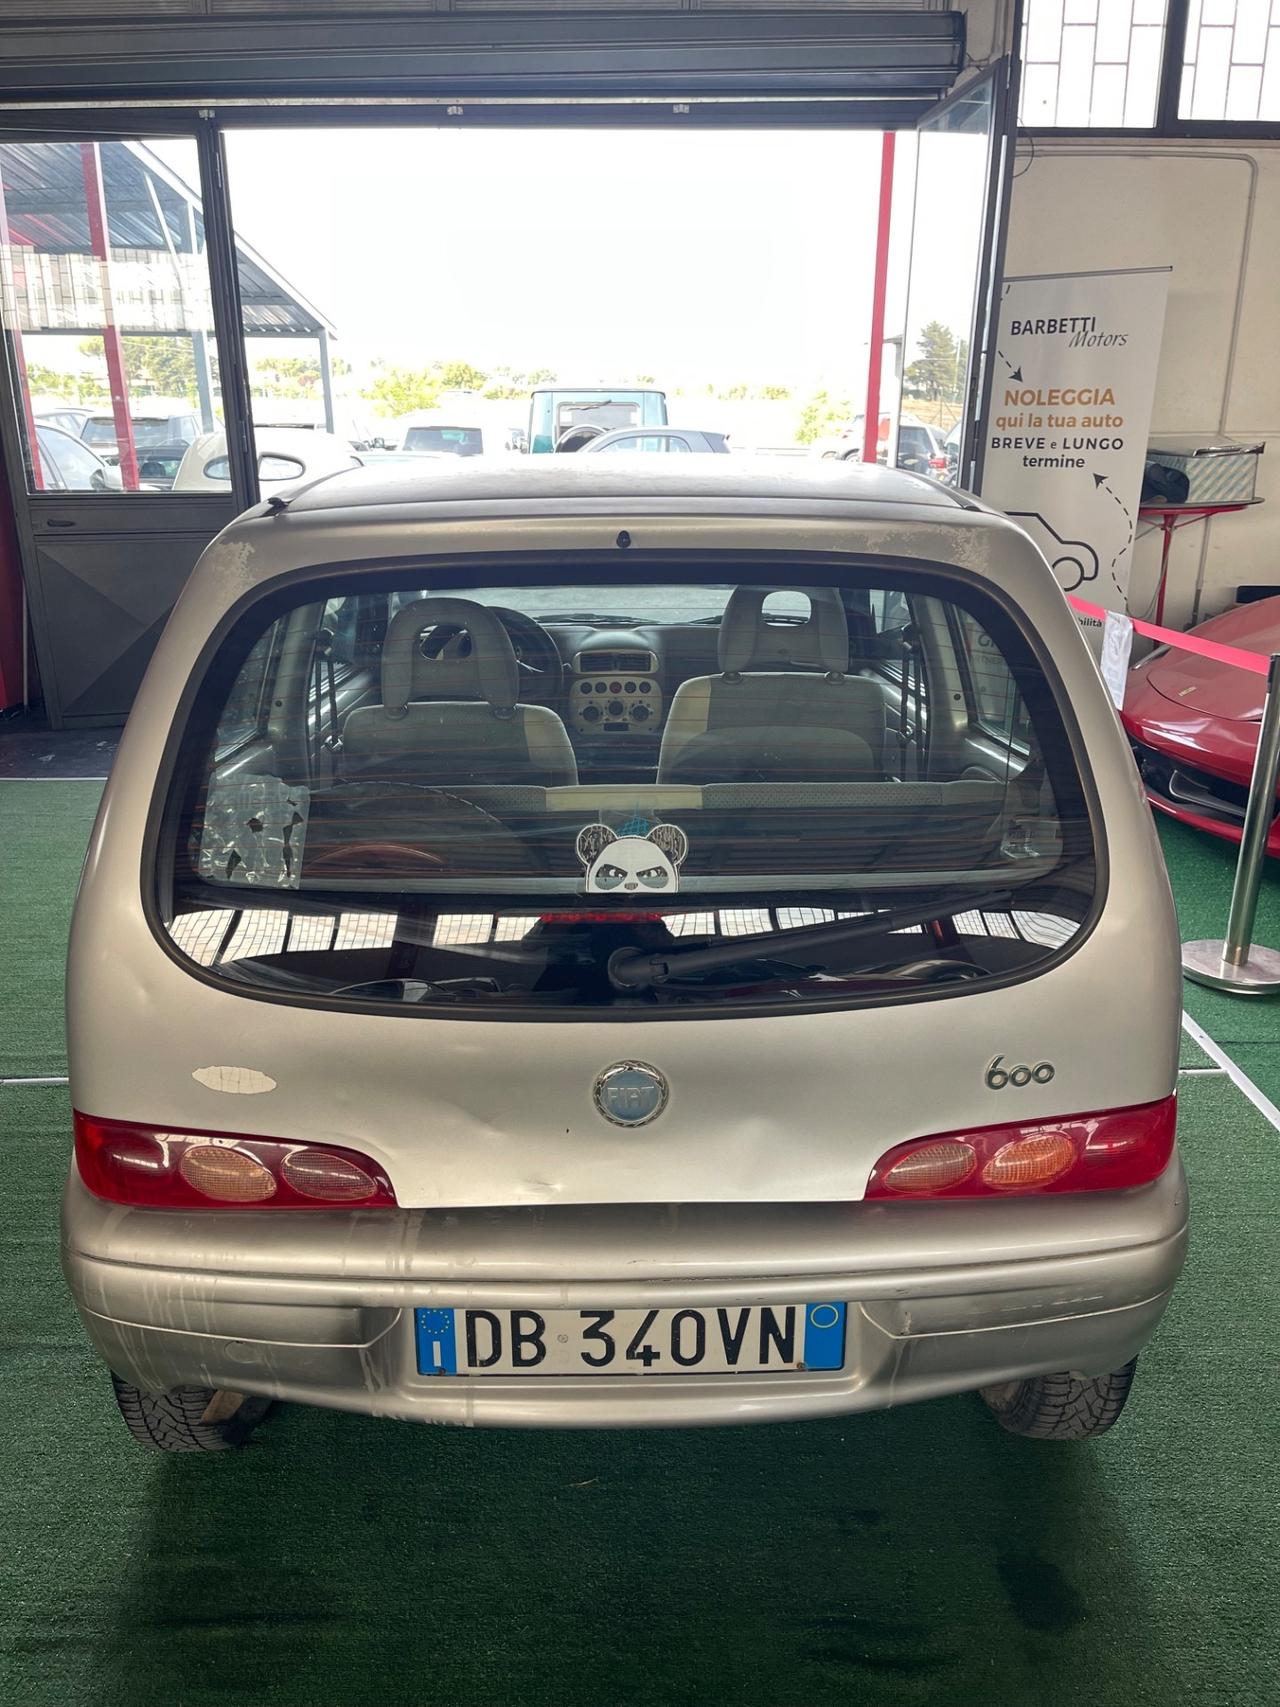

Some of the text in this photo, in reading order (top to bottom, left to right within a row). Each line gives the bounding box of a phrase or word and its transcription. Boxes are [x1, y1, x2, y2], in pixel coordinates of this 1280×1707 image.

[1011, 317, 1096, 335] BARBETTI
[1068, 331, 1128, 348] Motors
[1004, 388, 1115, 406] NOLEGGIA
[996, 413, 1124, 431] qui la tua auto
[991, 437, 1123, 450] BREVE e LUNGO
[1023, 455, 1085, 468] termine
[985, 1055, 1055, 1090] 600
[607, 1086, 655, 1107] FIAT
[465, 1310, 546, 1368] DB
